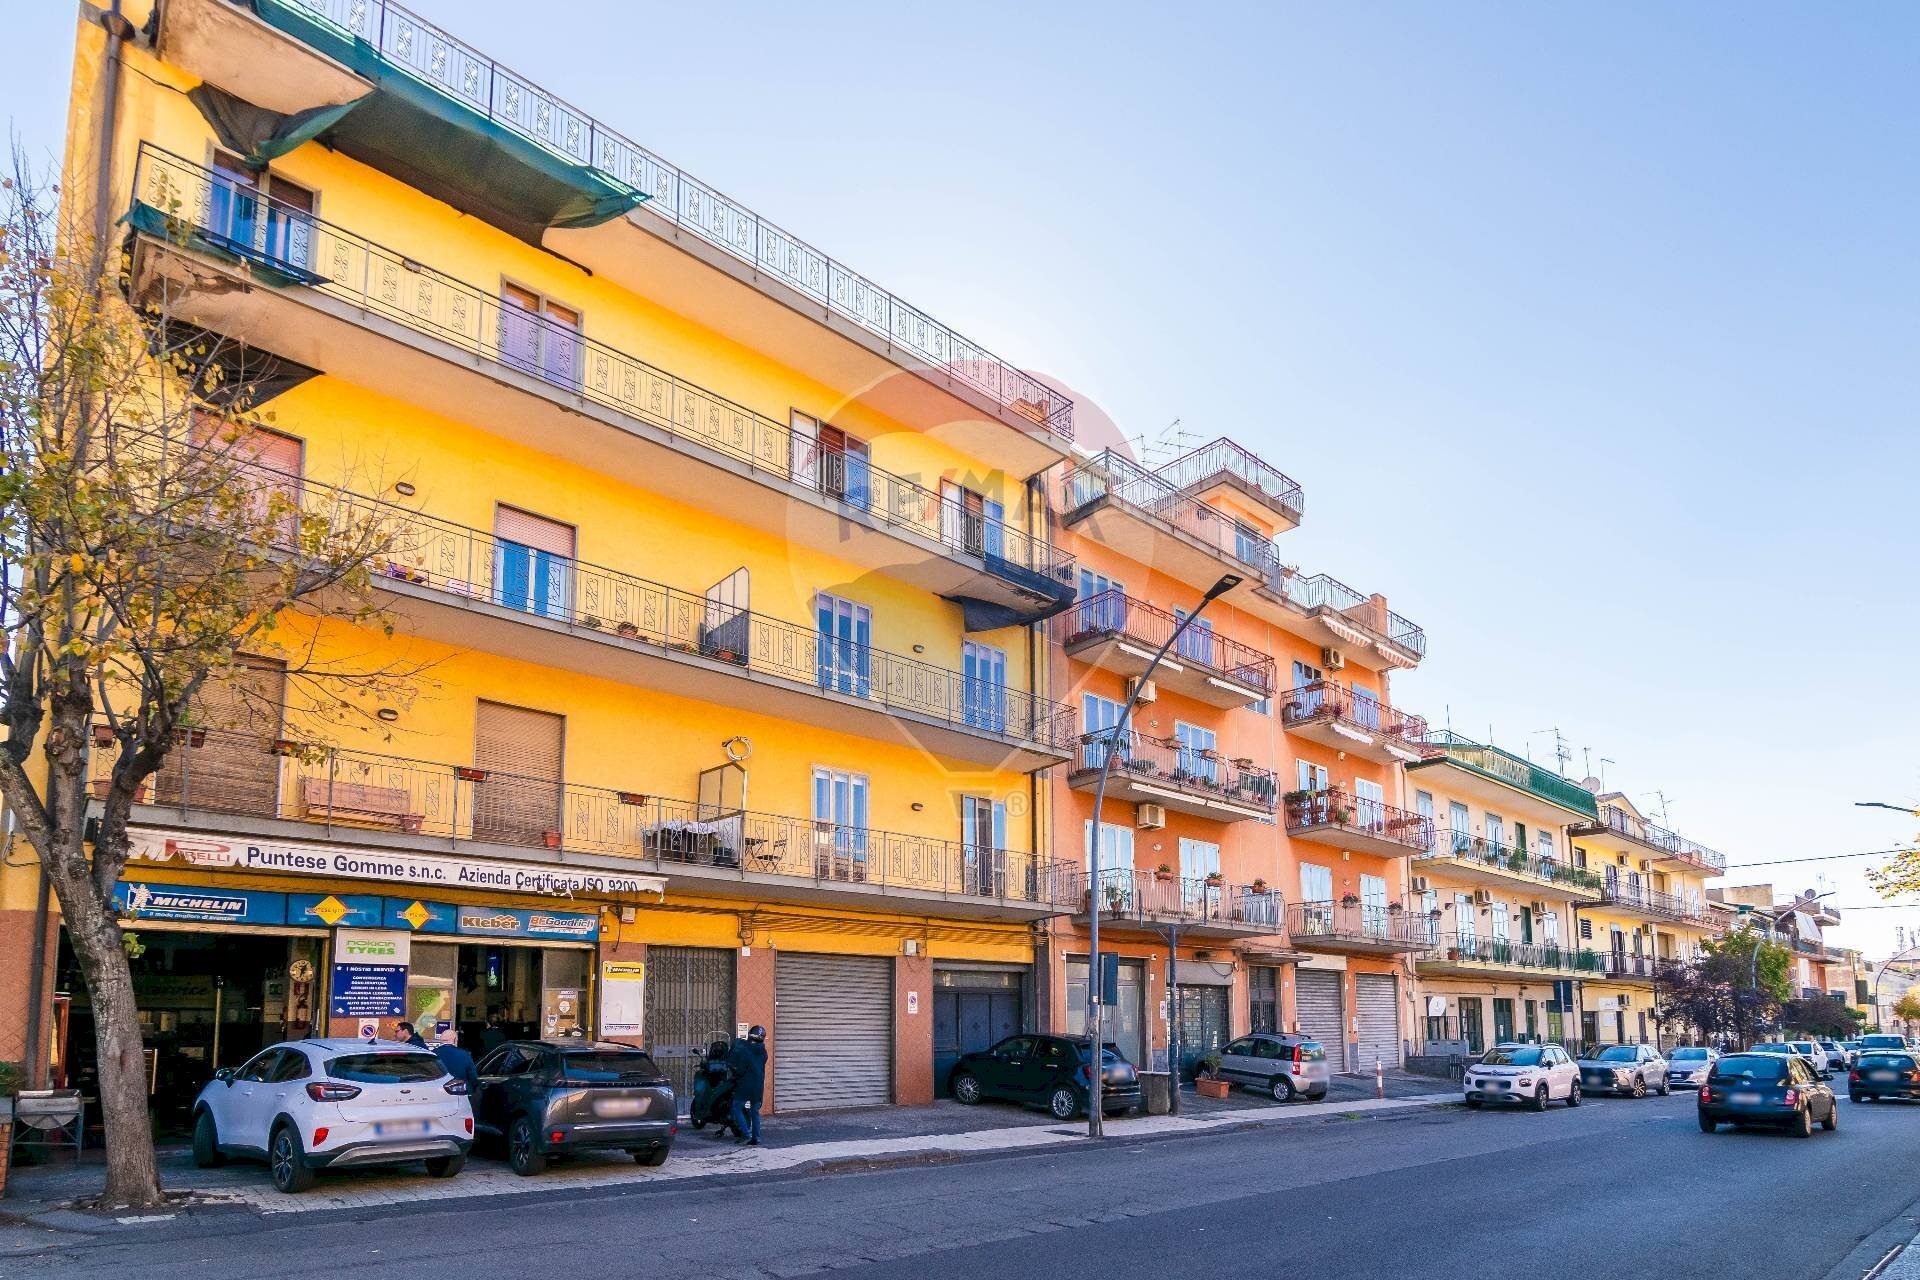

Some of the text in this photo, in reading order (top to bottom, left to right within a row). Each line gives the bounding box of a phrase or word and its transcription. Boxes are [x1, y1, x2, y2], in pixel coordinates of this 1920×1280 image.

[165, 839, 231, 863] PRELLI
[247, 846, 326, 869] Puntese
[333, 855, 404, 876] Gomme
[408, 867, 446, 879] s.n.c.
[459, 867, 511, 885] Azienda
[515, 872, 579, 891] Certificata
[583, 878, 603, 892] ISO
[153, 896, 242, 911] MICHELIN
[462, 915, 520, 930] Kleber
[530, 916, 595, 928] BFGoodrich
[347, 946, 395, 954] TYRES
